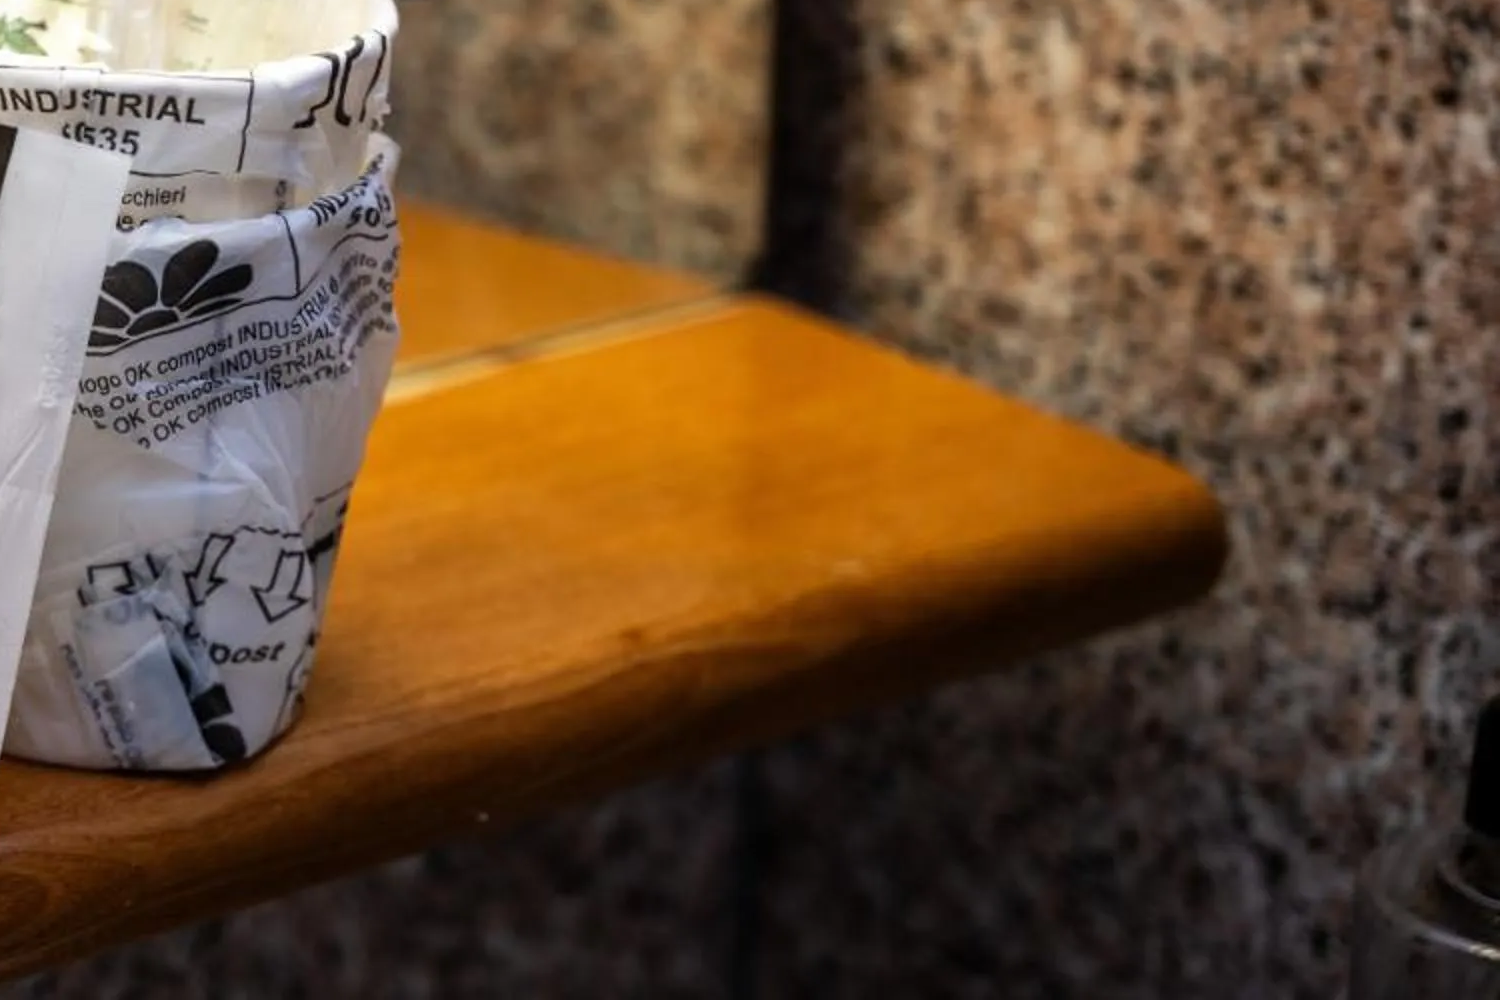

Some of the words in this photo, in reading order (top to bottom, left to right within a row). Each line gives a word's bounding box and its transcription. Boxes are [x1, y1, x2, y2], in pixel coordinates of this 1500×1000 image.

[79, 375, 122, 396] logo
[124, 360, 154, 387] OK
[157, 333, 233, 374] compost
[72, 402, 105, 419] he
[113, 407, 146, 434] OK
[153, 415, 185, 442] OK
